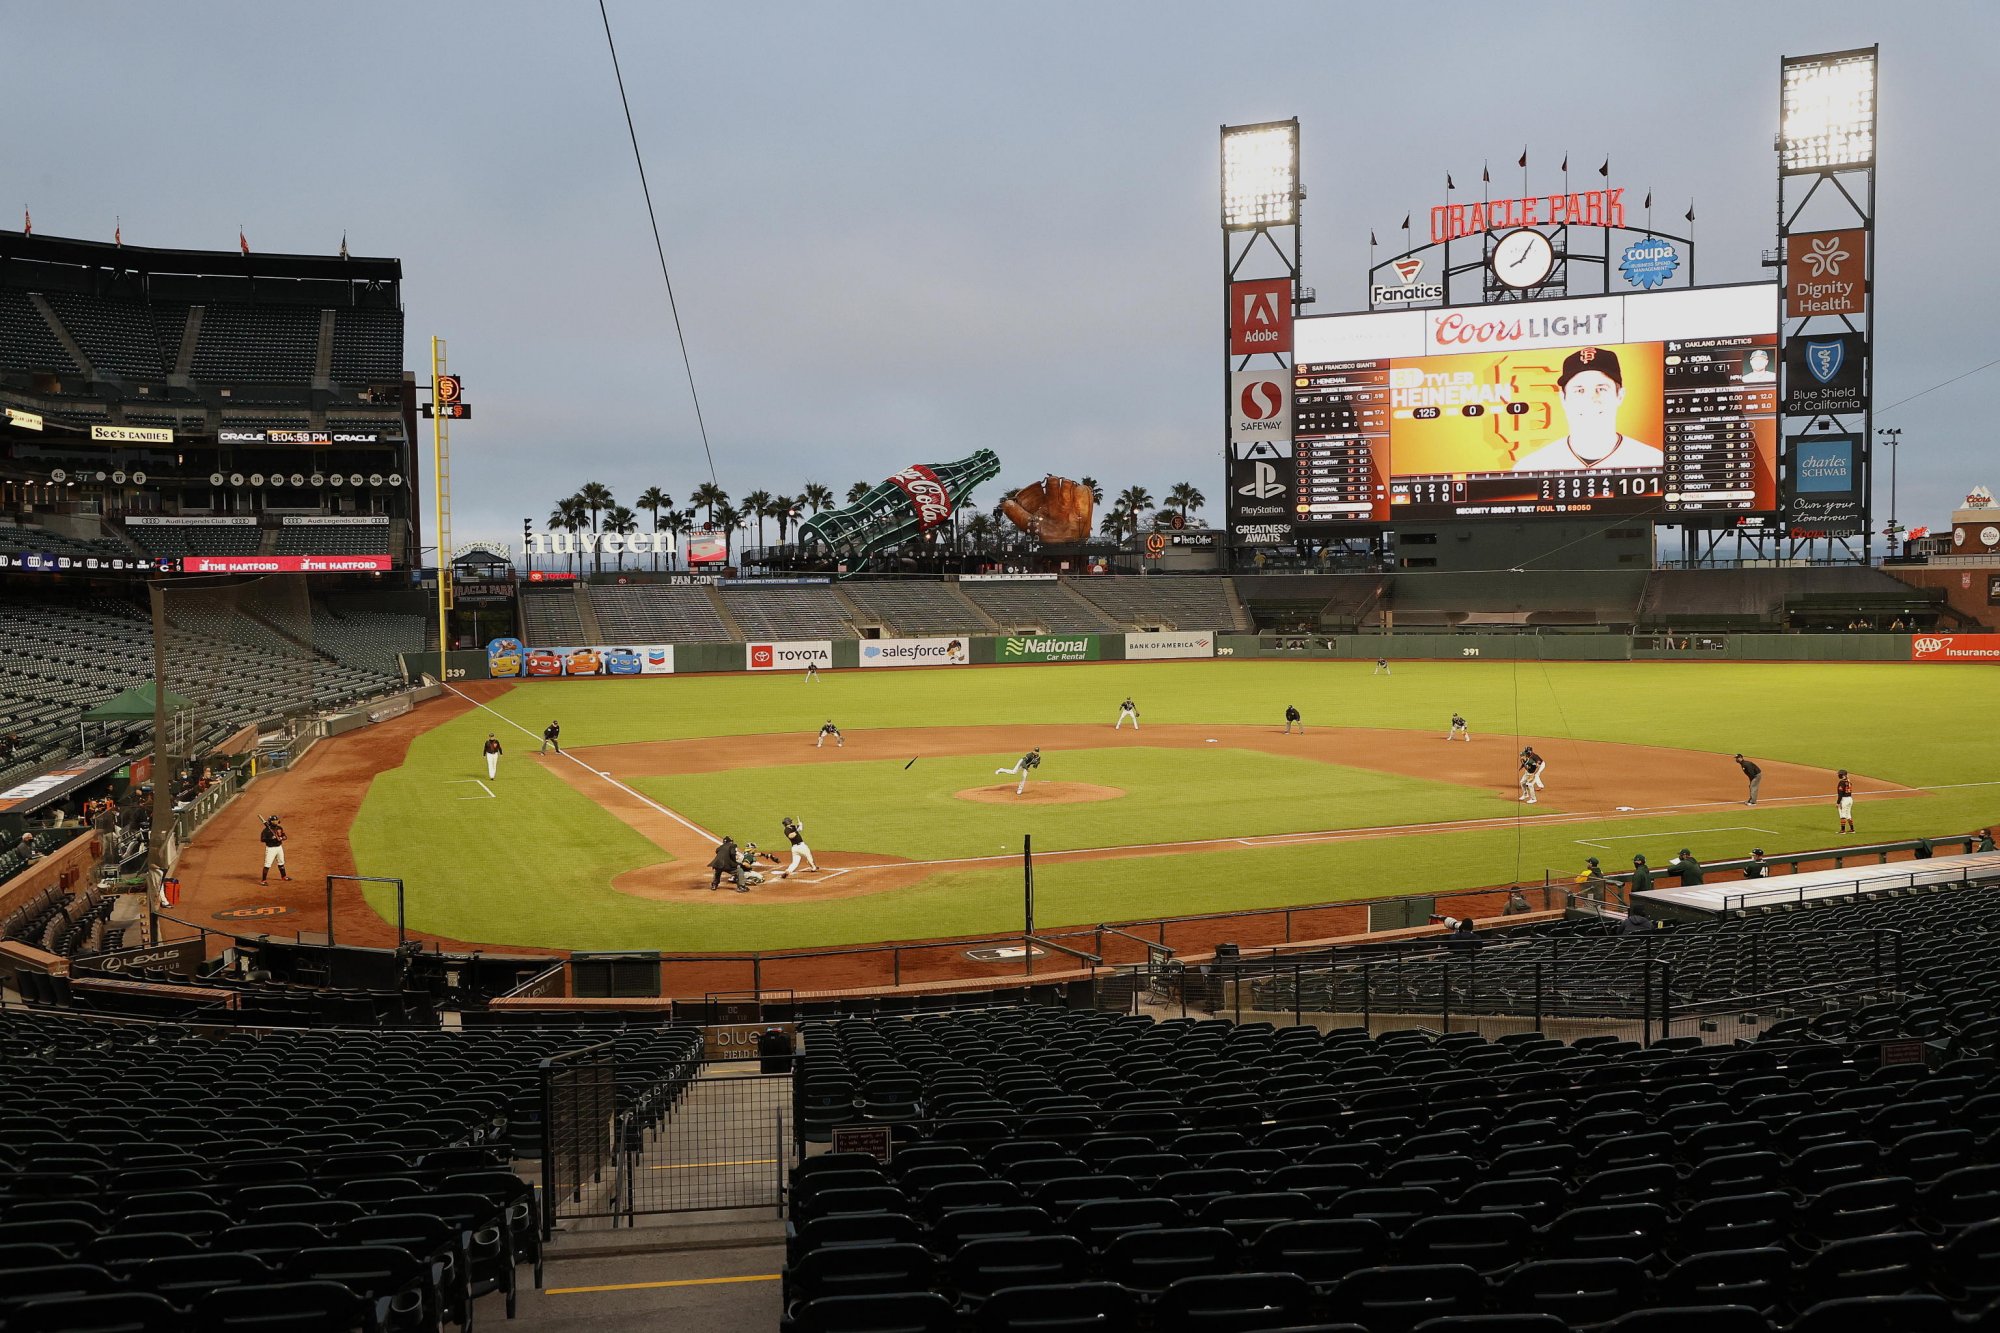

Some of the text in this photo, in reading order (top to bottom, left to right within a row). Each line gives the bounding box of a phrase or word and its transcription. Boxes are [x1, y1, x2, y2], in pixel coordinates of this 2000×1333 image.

[1431, 188, 1625, 243] ORACLE PARK
[1628, 246, 1673, 262] coupa
[1374, 283, 1442, 302] Fanatics
[1797, 281, 1853, 298] Dignity
[1800, 296, 1850, 312] Health
[1435, 313, 1607, 345] Coors LIGHT
[1245, 329, 1278, 342] Adobe
[1424, 372, 1474, 386] TYLER
[1392, 384, 1511, 407] HEINEMAN
[1794, 387, 1855, 399] Blue Shield
[1417, 408, 1436, 418] .125
[1469, 406, 1476, 415] 0
[1514, 404, 1520, 412] 0
[1790, 399, 1860, 411] of California
[1241, 421, 1282, 430] SAFEWAY
[95, 428, 168, 440] See's CANDIES
[220, 433, 265, 441] ORACLE
[272, 433, 309, 442] 8:04:59
[312, 433, 328, 442] PM
[1802, 454, 1846, 468] charles
[1802, 468, 1846, 477] SCHWAB
[1415, 484, 1421, 492] 0
[1428, 484, 1435, 492] 2
[1442, 484, 1449, 492] 0
[1456, 483, 1463, 491] 0
[1543, 480, 1549, 489] 2
[1558, 480, 1565, 488] 2
[1573, 479, 1580, 488] 0
[1588, 479, 1595, 487] 2
[1602, 478, 1610, 487] 4
[1430, 494, 1434, 502] 1
[1442, 493, 1449, 502] 0
[1543, 490, 1549, 498] 2
[1558, 489, 1565, 498] 3
[1573, 489, 1580, 498] 0
[1588, 488, 1595, 497] 3
[1241, 506, 1283, 515] PlayStation
[1794, 498, 1855, 514] Own your
[324, 518, 349, 526] Legends
[1792, 512, 1858, 522] tomorrow
[1236, 524, 1288, 534] GREATNESS
[1826, 529, 1856, 537] LIGHT
[521, 532, 677, 554] nuveen
[1195, 535, 1212, 544] Coffee
[1245, 533, 1280, 542] AWAITS
[12, 558, 22, 566] Audi
[229, 562, 278, 570] HARTFORD
[329, 561, 377, 569] HARTFORD
[671, 575, 690, 585] FAN
[882, 644, 946, 658] salesforce
[1024, 638, 1088, 653] National
[778, 650, 828, 660] TOYOTA
[1946, 648, 2000, 656] Insurance
[1760, 867, 1768, 877] 41
[124, 950, 179, 967] LEXUS
[718, 1027, 760, 1046] blue
[724, 1050, 749, 1059] FIELD
